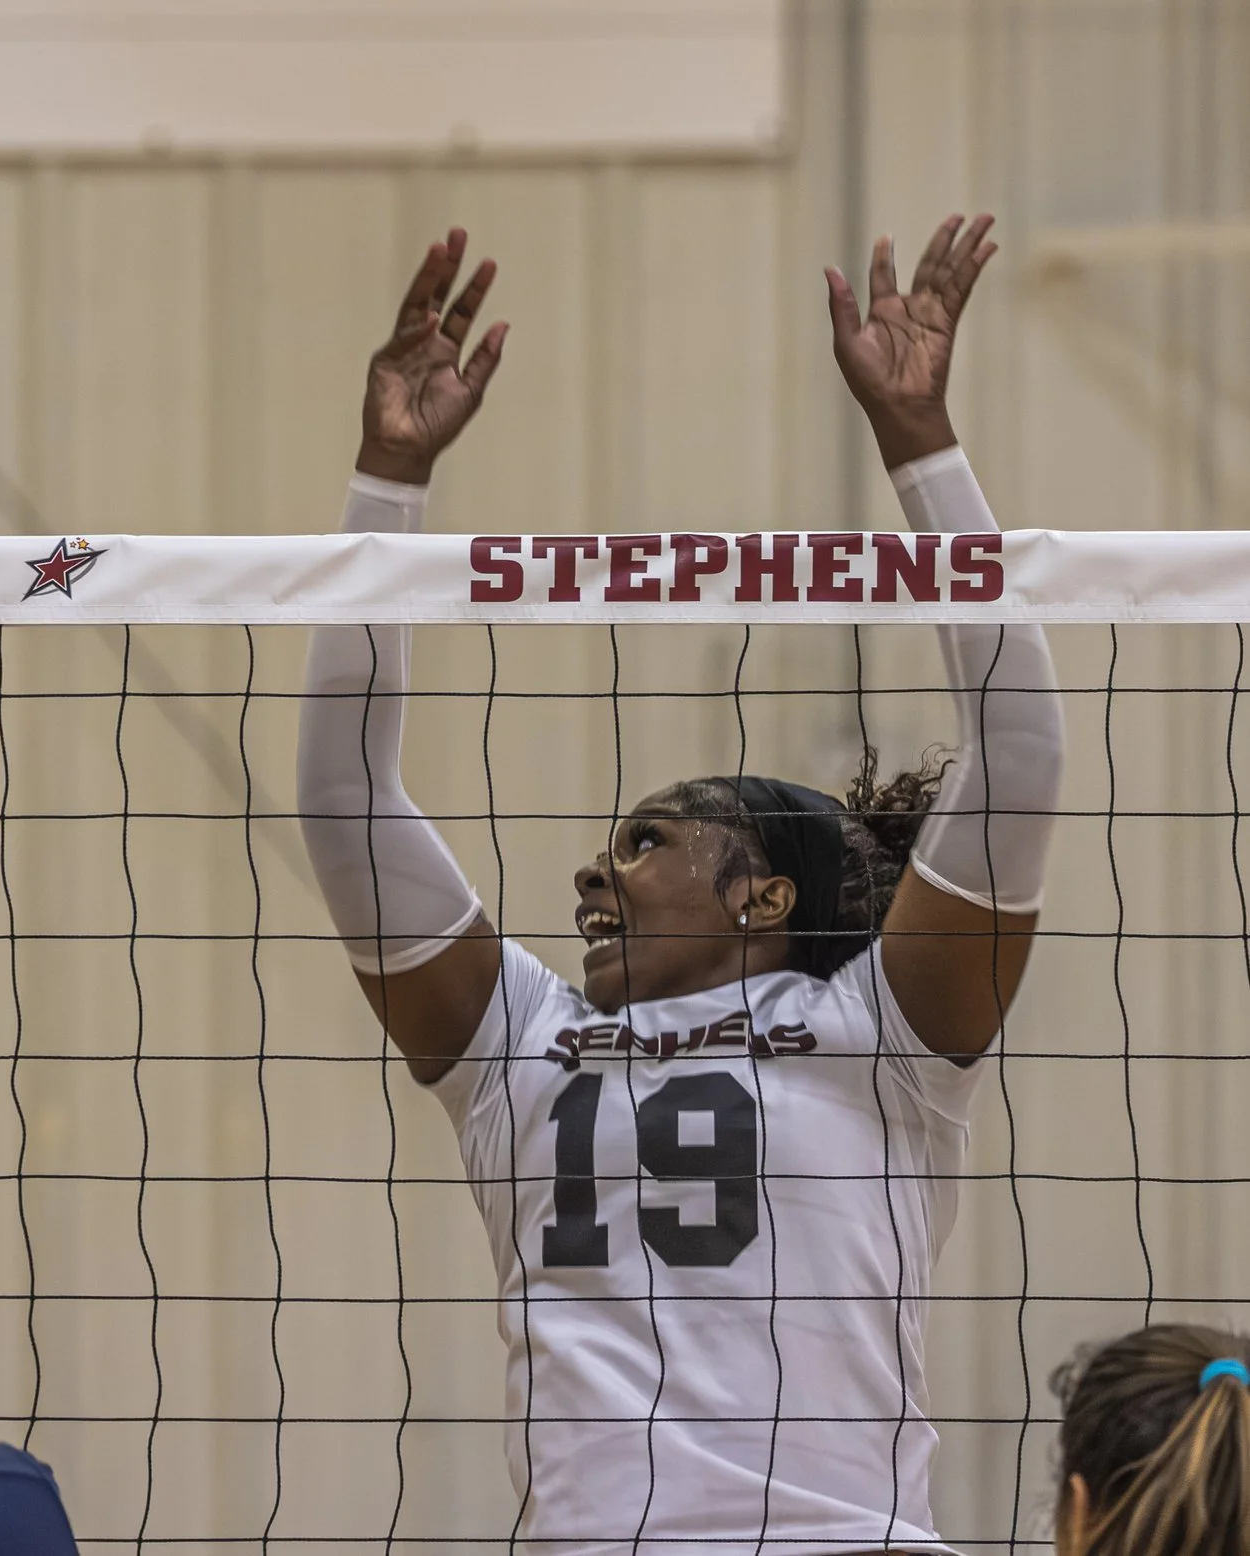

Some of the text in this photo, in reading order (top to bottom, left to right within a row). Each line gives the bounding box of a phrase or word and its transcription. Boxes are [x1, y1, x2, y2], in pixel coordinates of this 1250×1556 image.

[470, 533, 1004, 603] STEPHENS
[545, 1011, 818, 1070] SEPHES
[542, 1072, 758, 1267] 19
